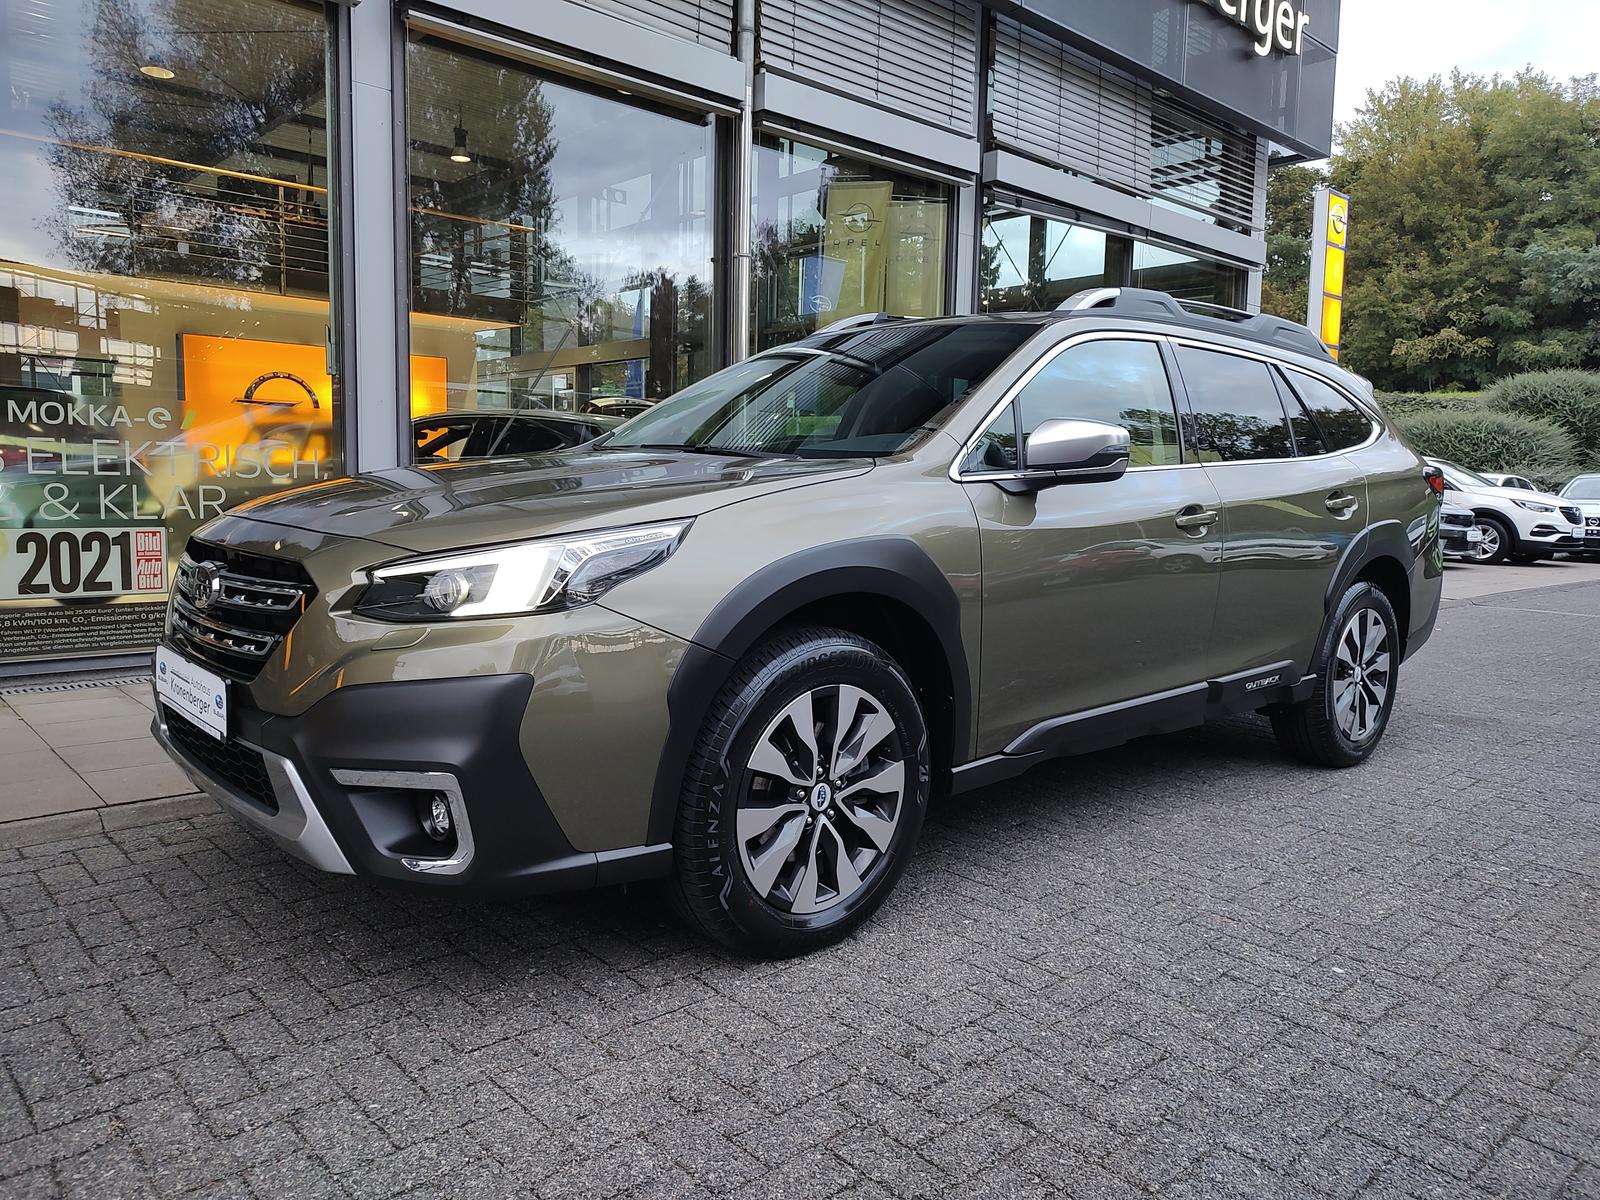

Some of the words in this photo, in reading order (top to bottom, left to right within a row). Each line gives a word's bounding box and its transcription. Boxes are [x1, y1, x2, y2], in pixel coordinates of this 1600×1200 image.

[832, 239, 881, 248] OPEL
[7, 399, 172, 430] MOKKA-e
[38, 482, 80, 521] &
[99, 482, 229, 520] KLAR
[15, 530, 133, 595] 2021
[12, 618, 53, 627] kWh/100
[1244, 674, 1281, 691] OUTBACK
